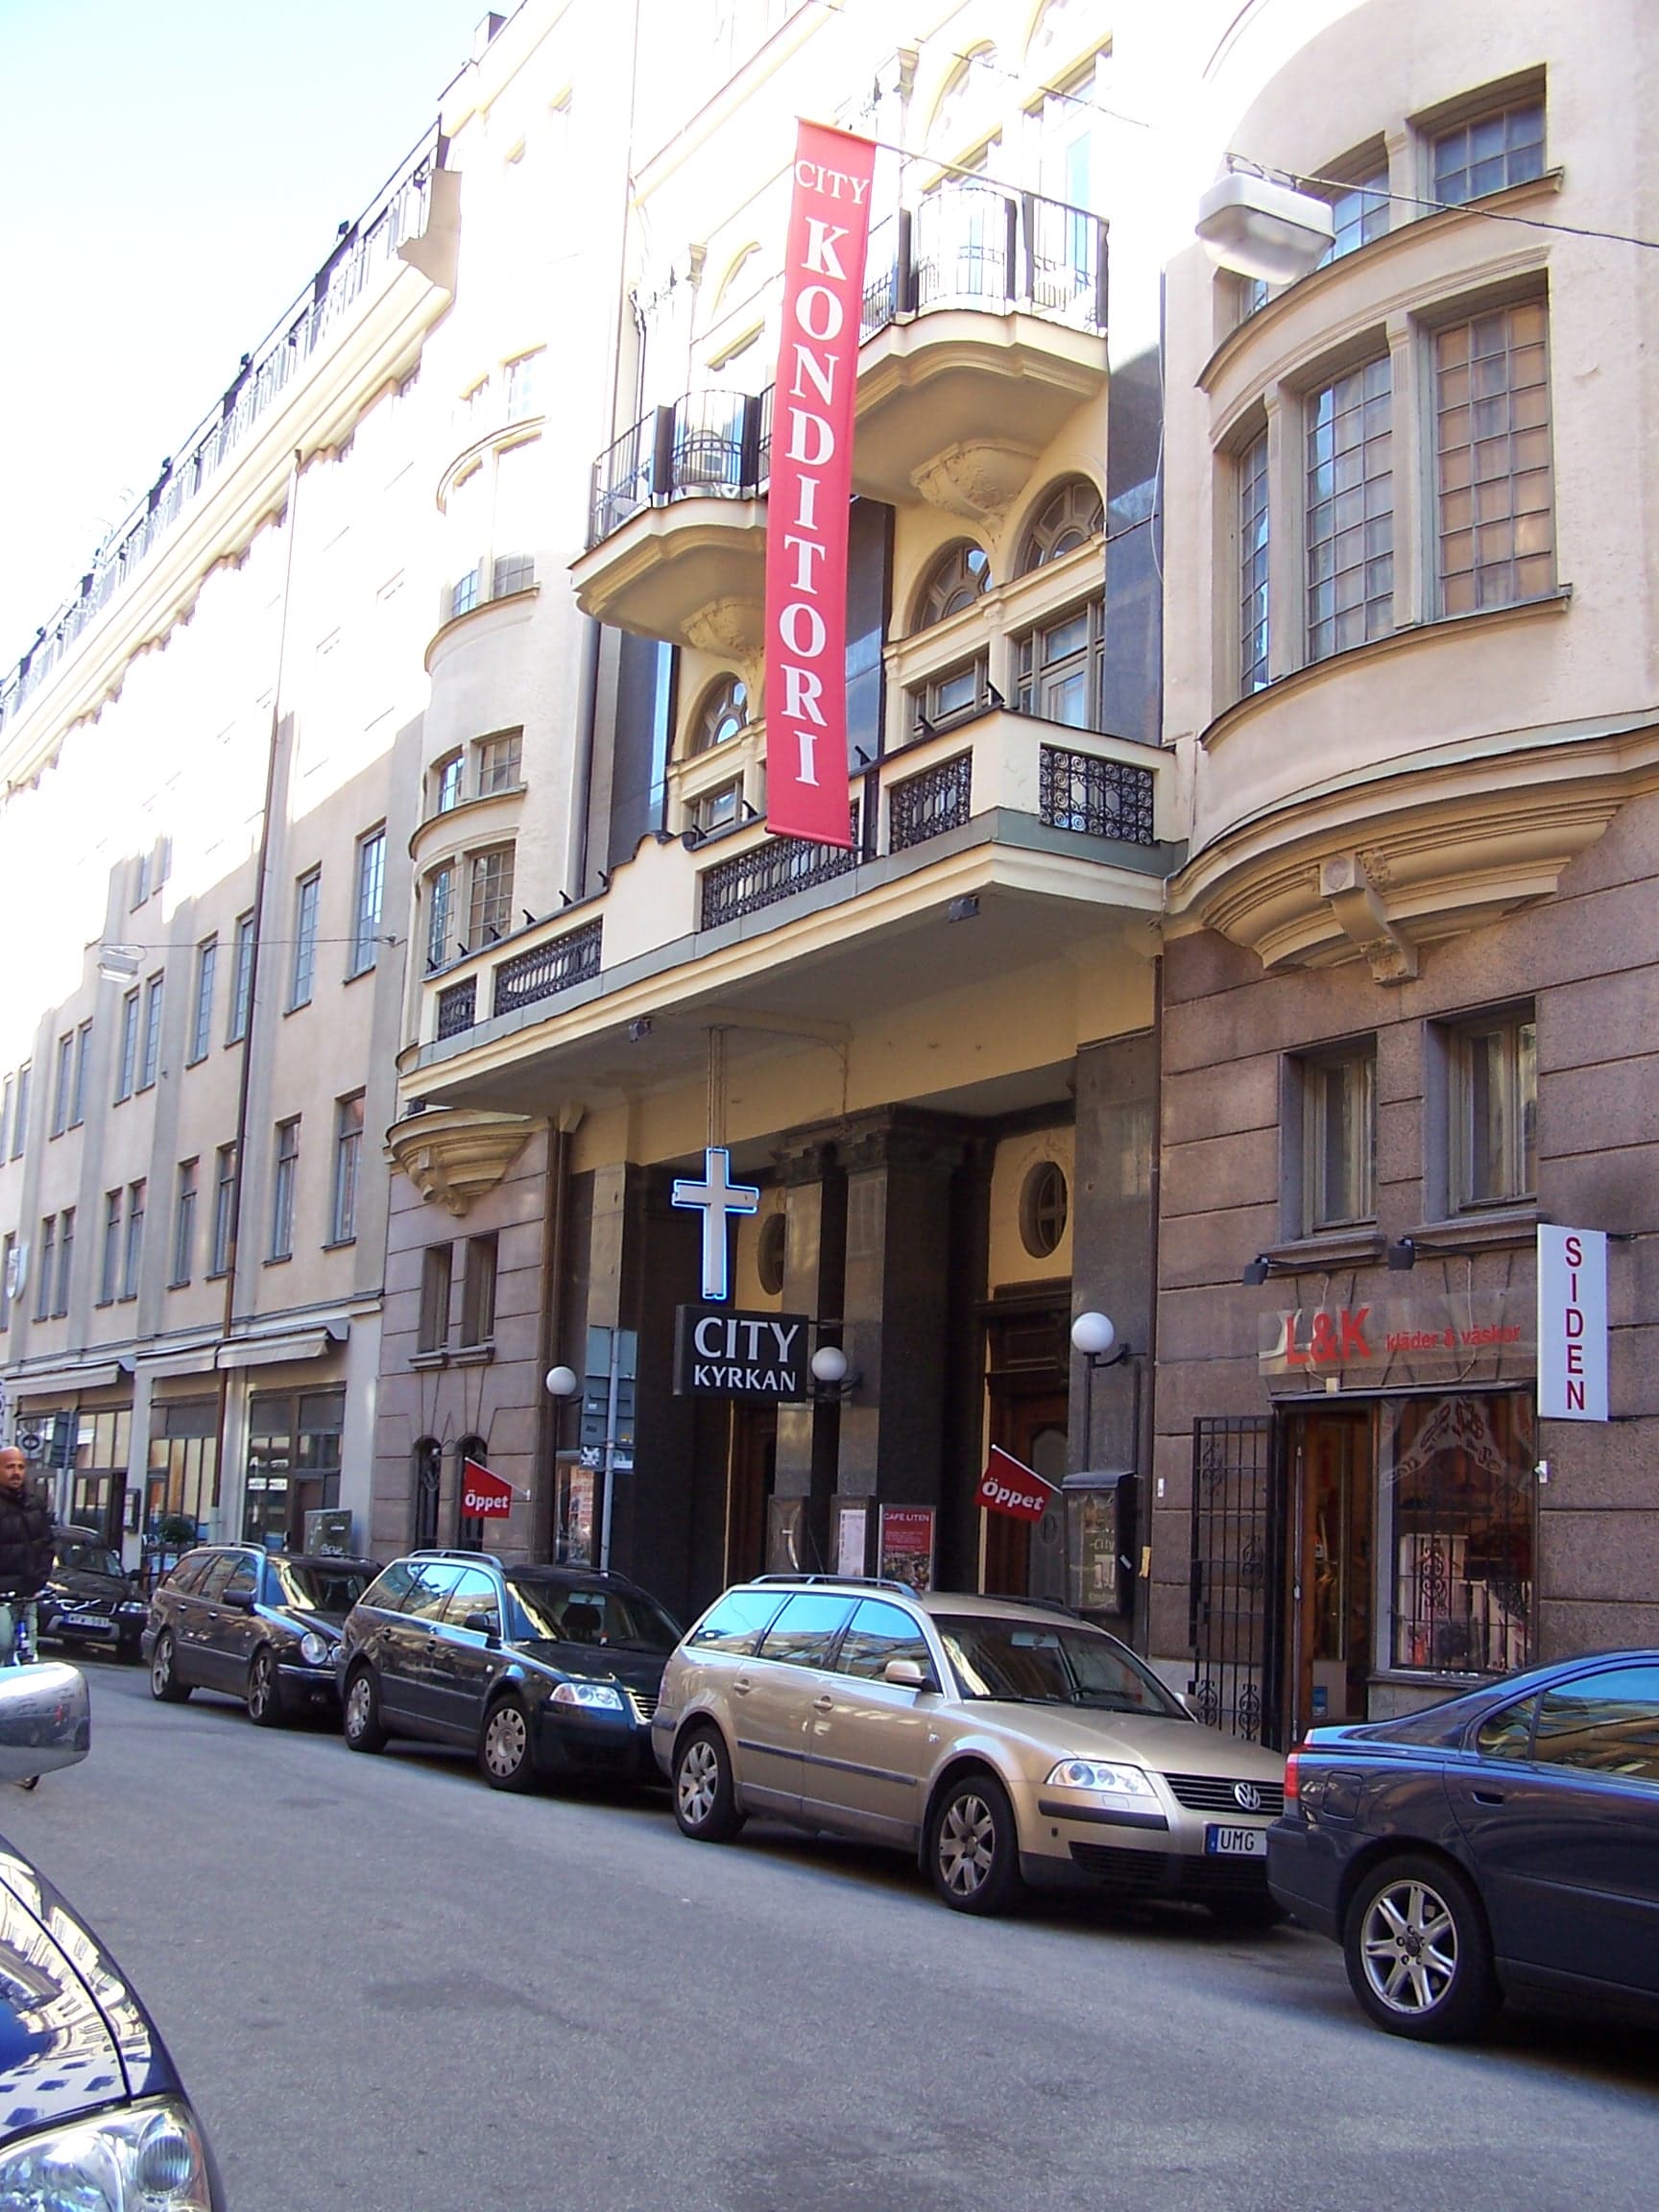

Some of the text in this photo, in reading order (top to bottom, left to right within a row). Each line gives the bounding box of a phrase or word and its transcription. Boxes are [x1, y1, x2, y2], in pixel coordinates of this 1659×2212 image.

[795, 159, 870, 204] CITY
[778, 215, 848, 787] KONDITORI
[694, 1316, 800, 1363] CITY
[1286, 1307, 1372, 1365] L&K
[1385, 1332, 1438, 1353] kläder
[1461, 1323, 1521, 1347] väskor
[1565, 1236, 1585, 1410] SIDEN
[693, 1364, 796, 1392] KYRKAN
[465, 1489, 509, 1511] Öppet
[981, 1477, 1046, 1511] Öppet
[1220, 1830, 1255, 1851] UMG
